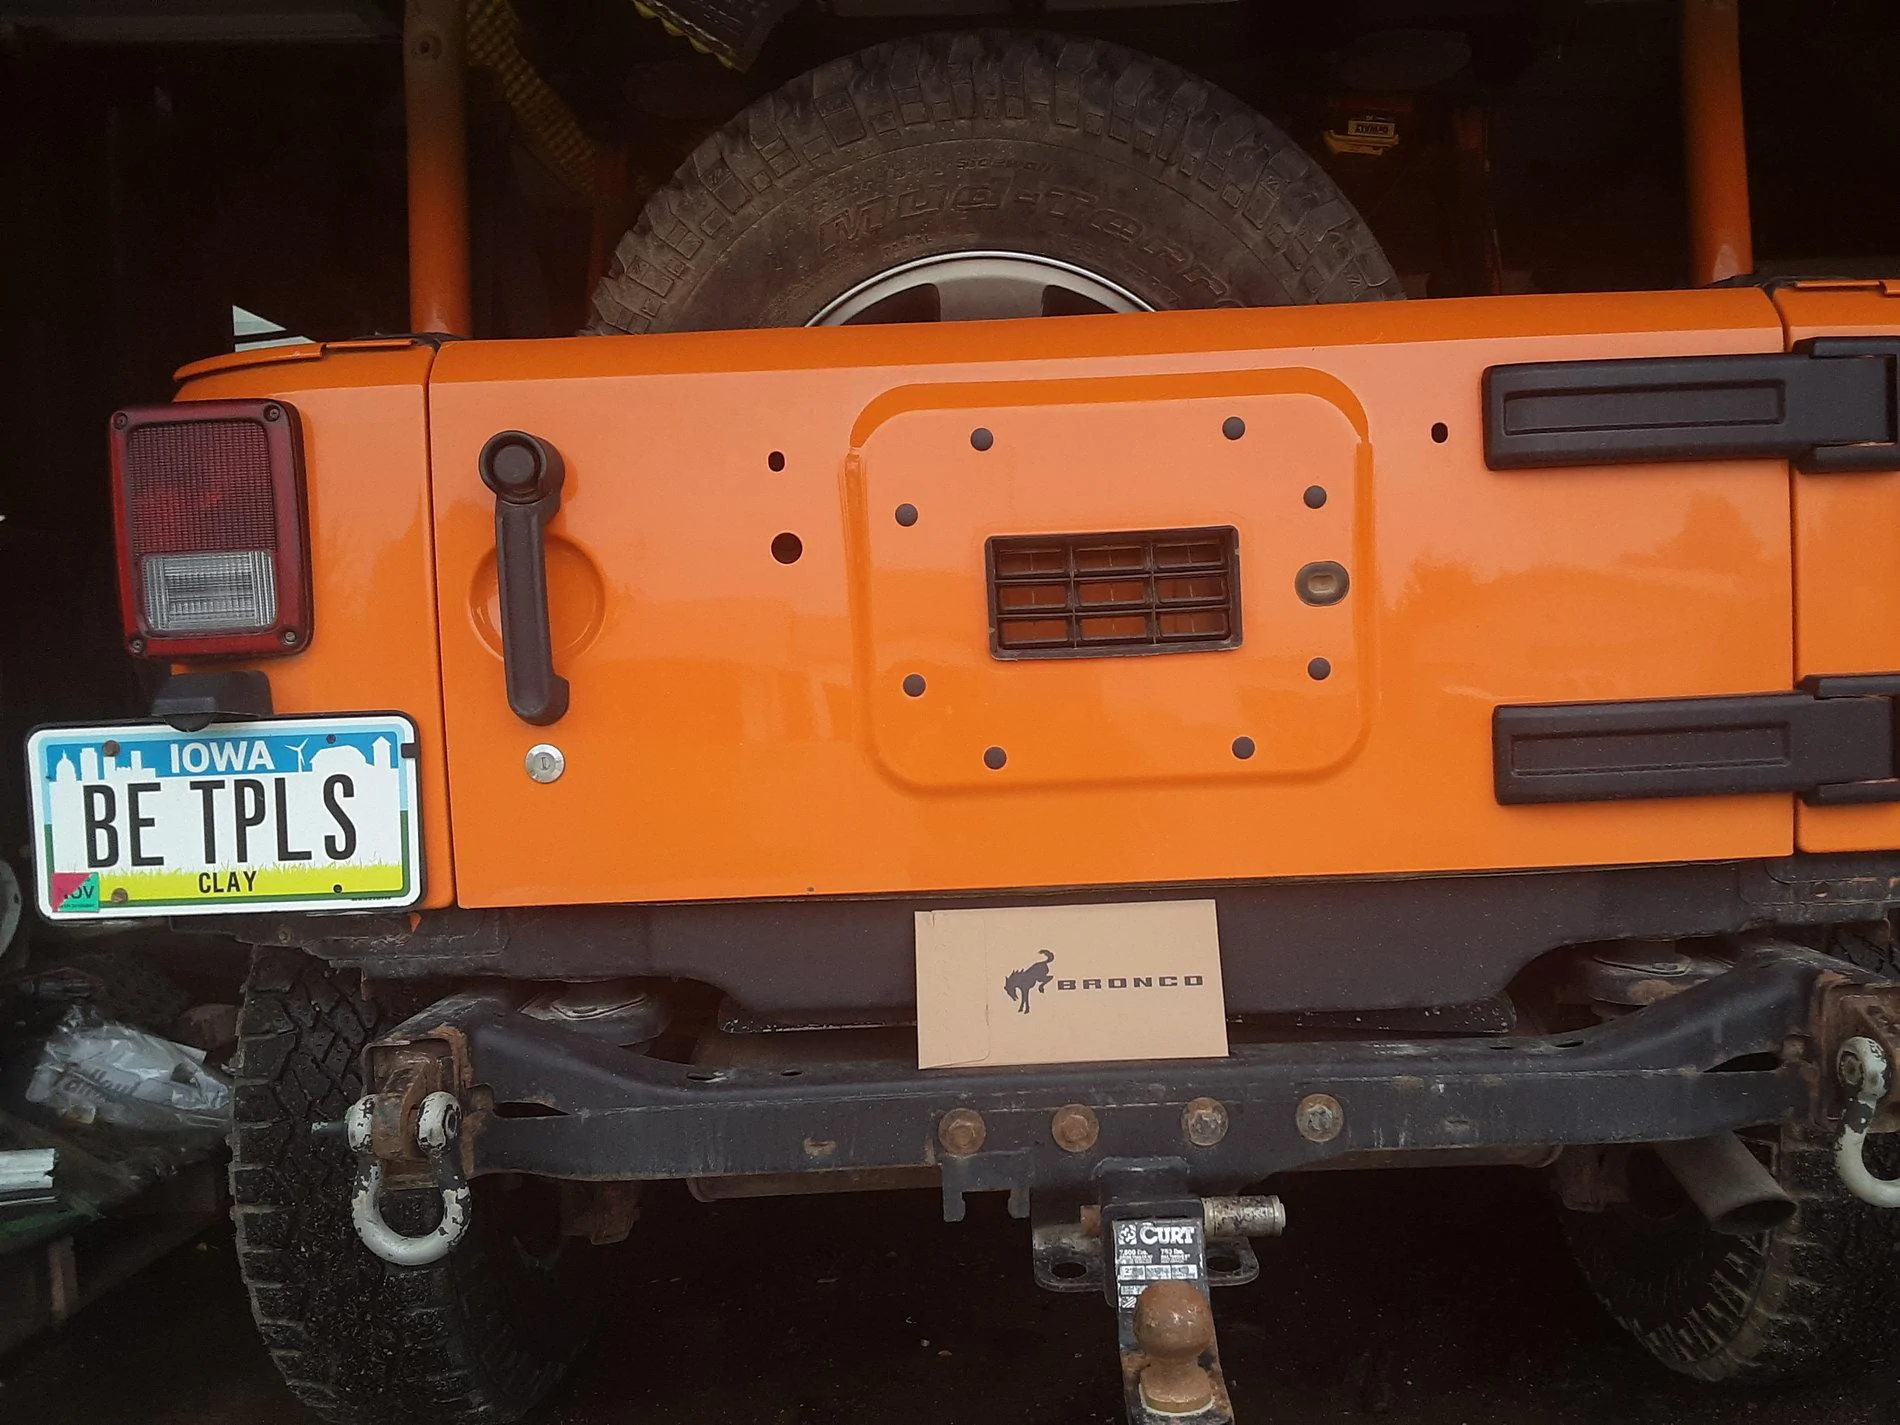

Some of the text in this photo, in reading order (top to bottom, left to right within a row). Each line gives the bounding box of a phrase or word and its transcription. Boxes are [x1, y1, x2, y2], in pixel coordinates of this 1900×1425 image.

[169, 740, 275, 774] IOWA
[82, 773, 357, 869] BE TPLS
[198, 870, 257, 894] CLAY
[1057, 975, 1204, 991] BRONCO
[1139, 1222, 1195, 1245] CURT
